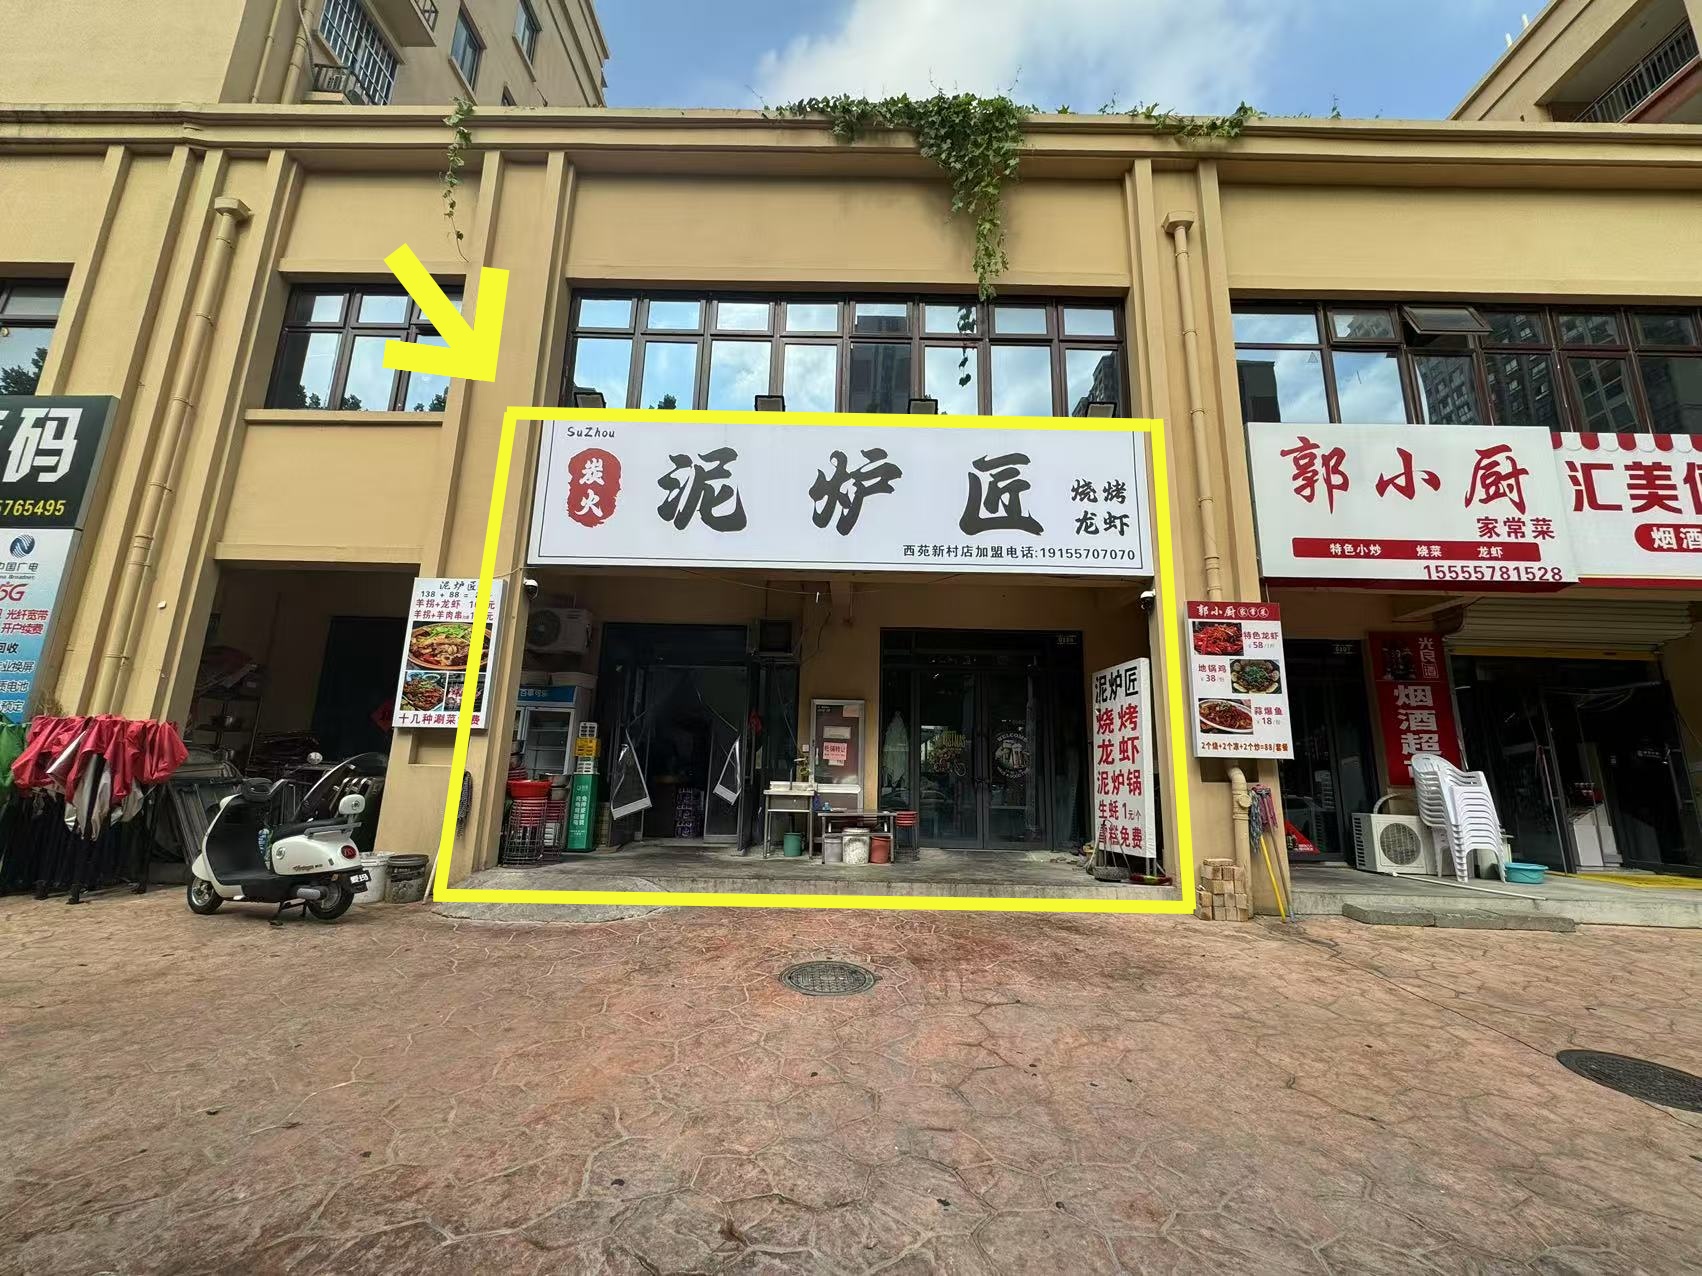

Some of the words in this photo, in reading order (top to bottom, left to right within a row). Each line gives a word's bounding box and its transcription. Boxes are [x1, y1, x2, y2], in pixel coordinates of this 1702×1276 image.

[567, 426, 615, 438] SuZhou
[0, 408, 83, 482] 码
[578, 458, 605, 516] 炭火
[1279, 436, 1529, 514] 郭小厨
[657, 446, 1044, 537] 泥炉匠
[1071, 479, 1127, 505] 烧烤
[1075, 513, 1130, 537] 龙虾
[1476, 517, 1556, 541] 家常菜
[1651, 527, 1702, 549] 烟酒
[1330, 543, 1382, 557] 特色小炒
[1416, 544, 1443, 558] 烧菜
[1477, 546, 1504, 559] 龙虾
[1423, 564, 1564, 582] 15555781528
[1196, 604, 1236, 618] 郭小厨
[1243, 631, 1279, 640] 特色龙虾
[0, 661, 35, 672] 业换屏
[1198, 664, 1227, 673] 地锅鸡
[1095, 666, 1139, 704] 泥炉匠
[398, 713, 480, 725] 十几种涮菜费
[1096, 703, 1139, 734] 烧烤
[1097, 736, 1140, 765] 龙虾
[1097, 769, 1142, 797] 泥炉锅
[1098, 799, 1119, 821] 生蚝
